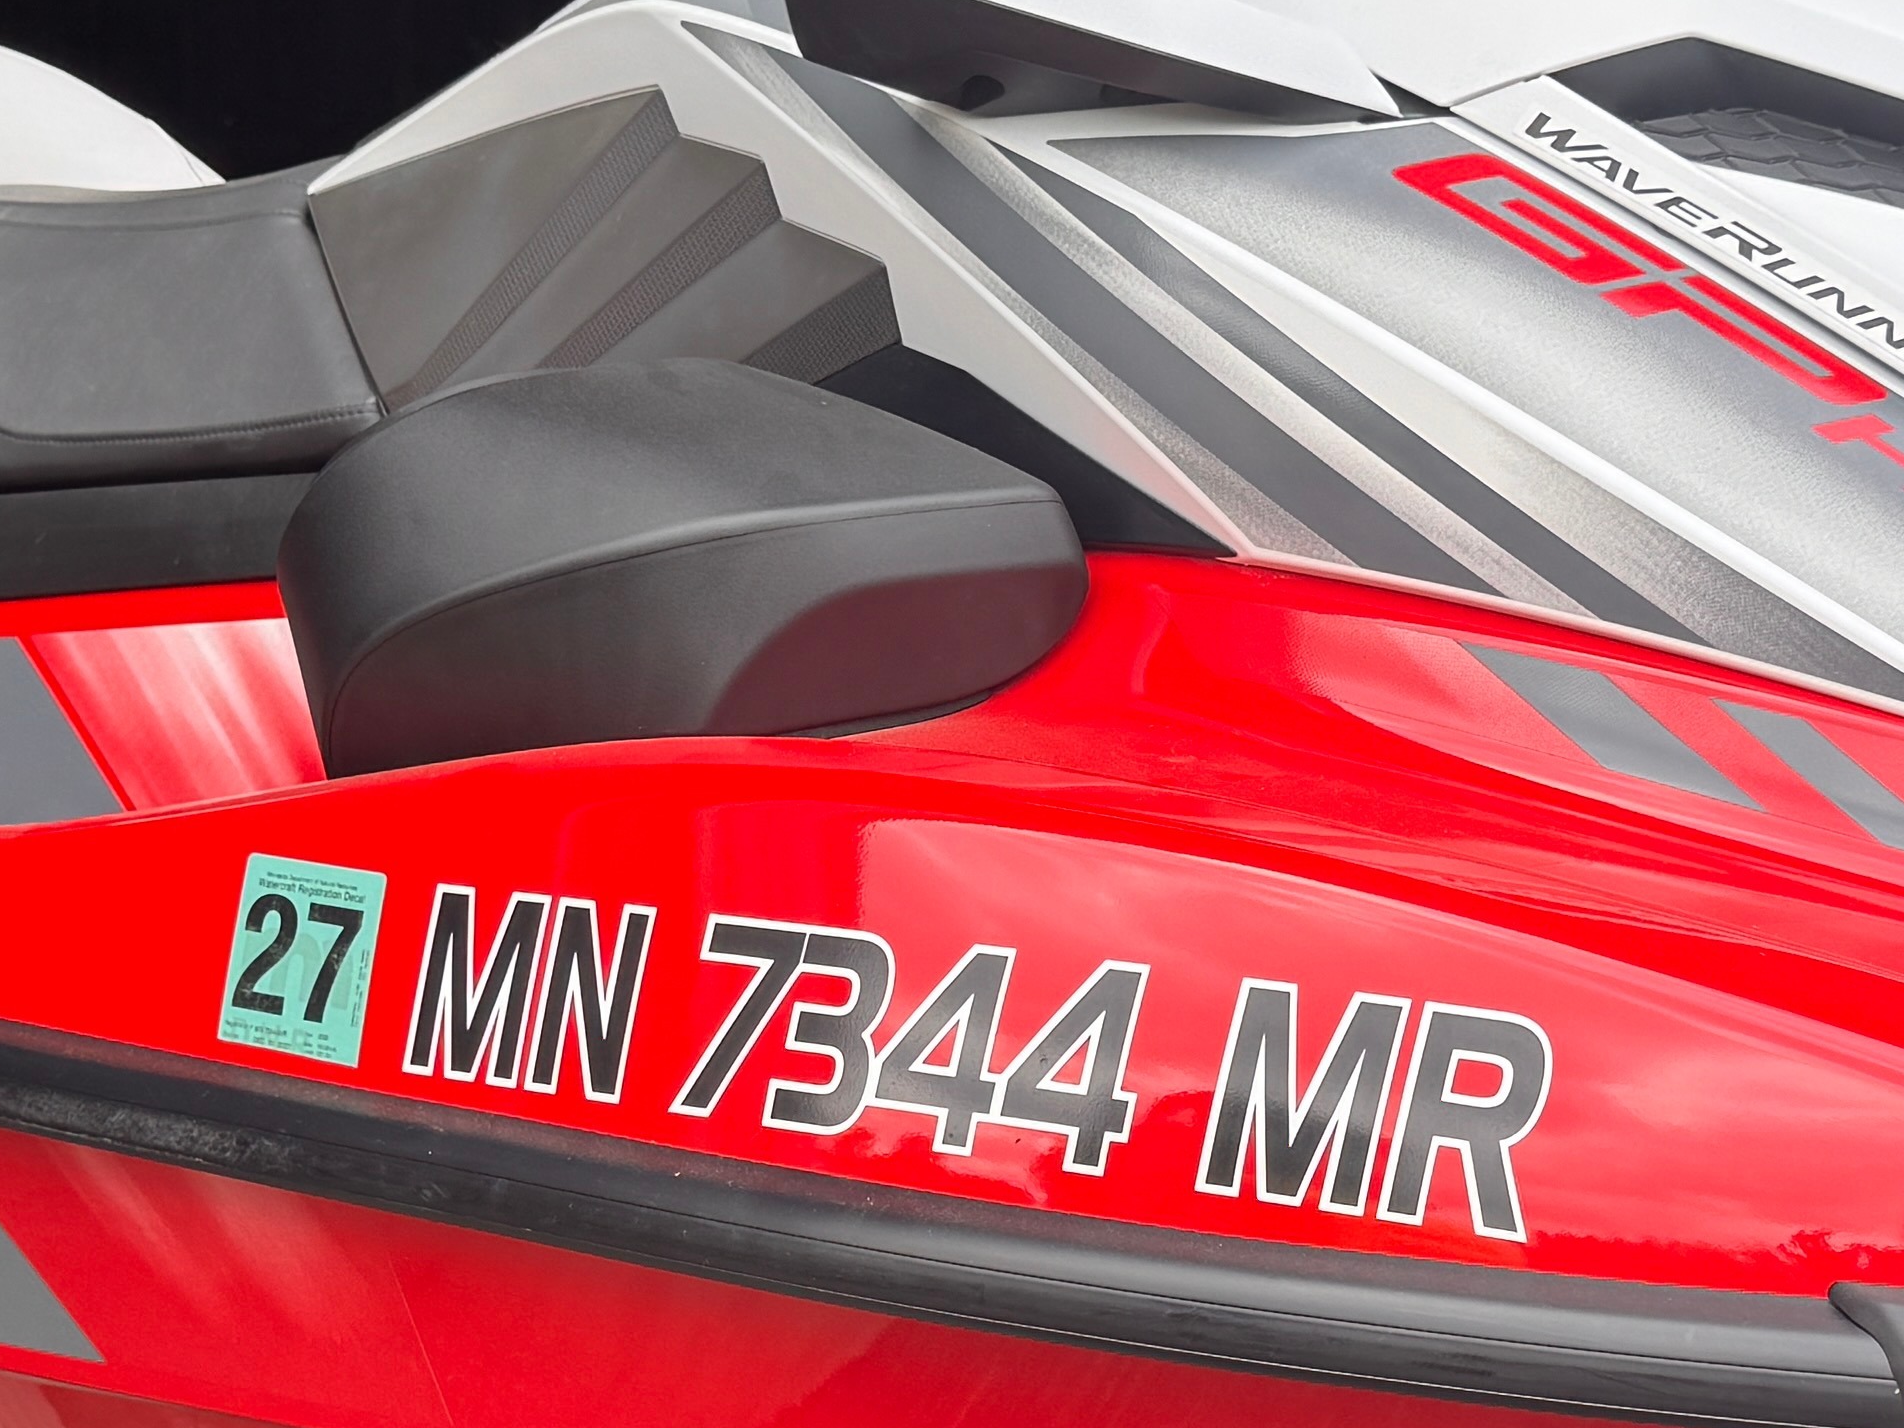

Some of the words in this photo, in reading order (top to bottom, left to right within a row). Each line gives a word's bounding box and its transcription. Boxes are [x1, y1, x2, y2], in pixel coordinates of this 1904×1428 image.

[1392, 152, 1887, 406] GP
[231, 893, 364, 1023] 27
[297, 883, 342, 901] Registration
[343, 891, 365, 904] Decal
[403, 884, 656, 1103] MN
[670, 914, 1150, 1176] 7344
[1195, 978, 1554, 1243] MR
